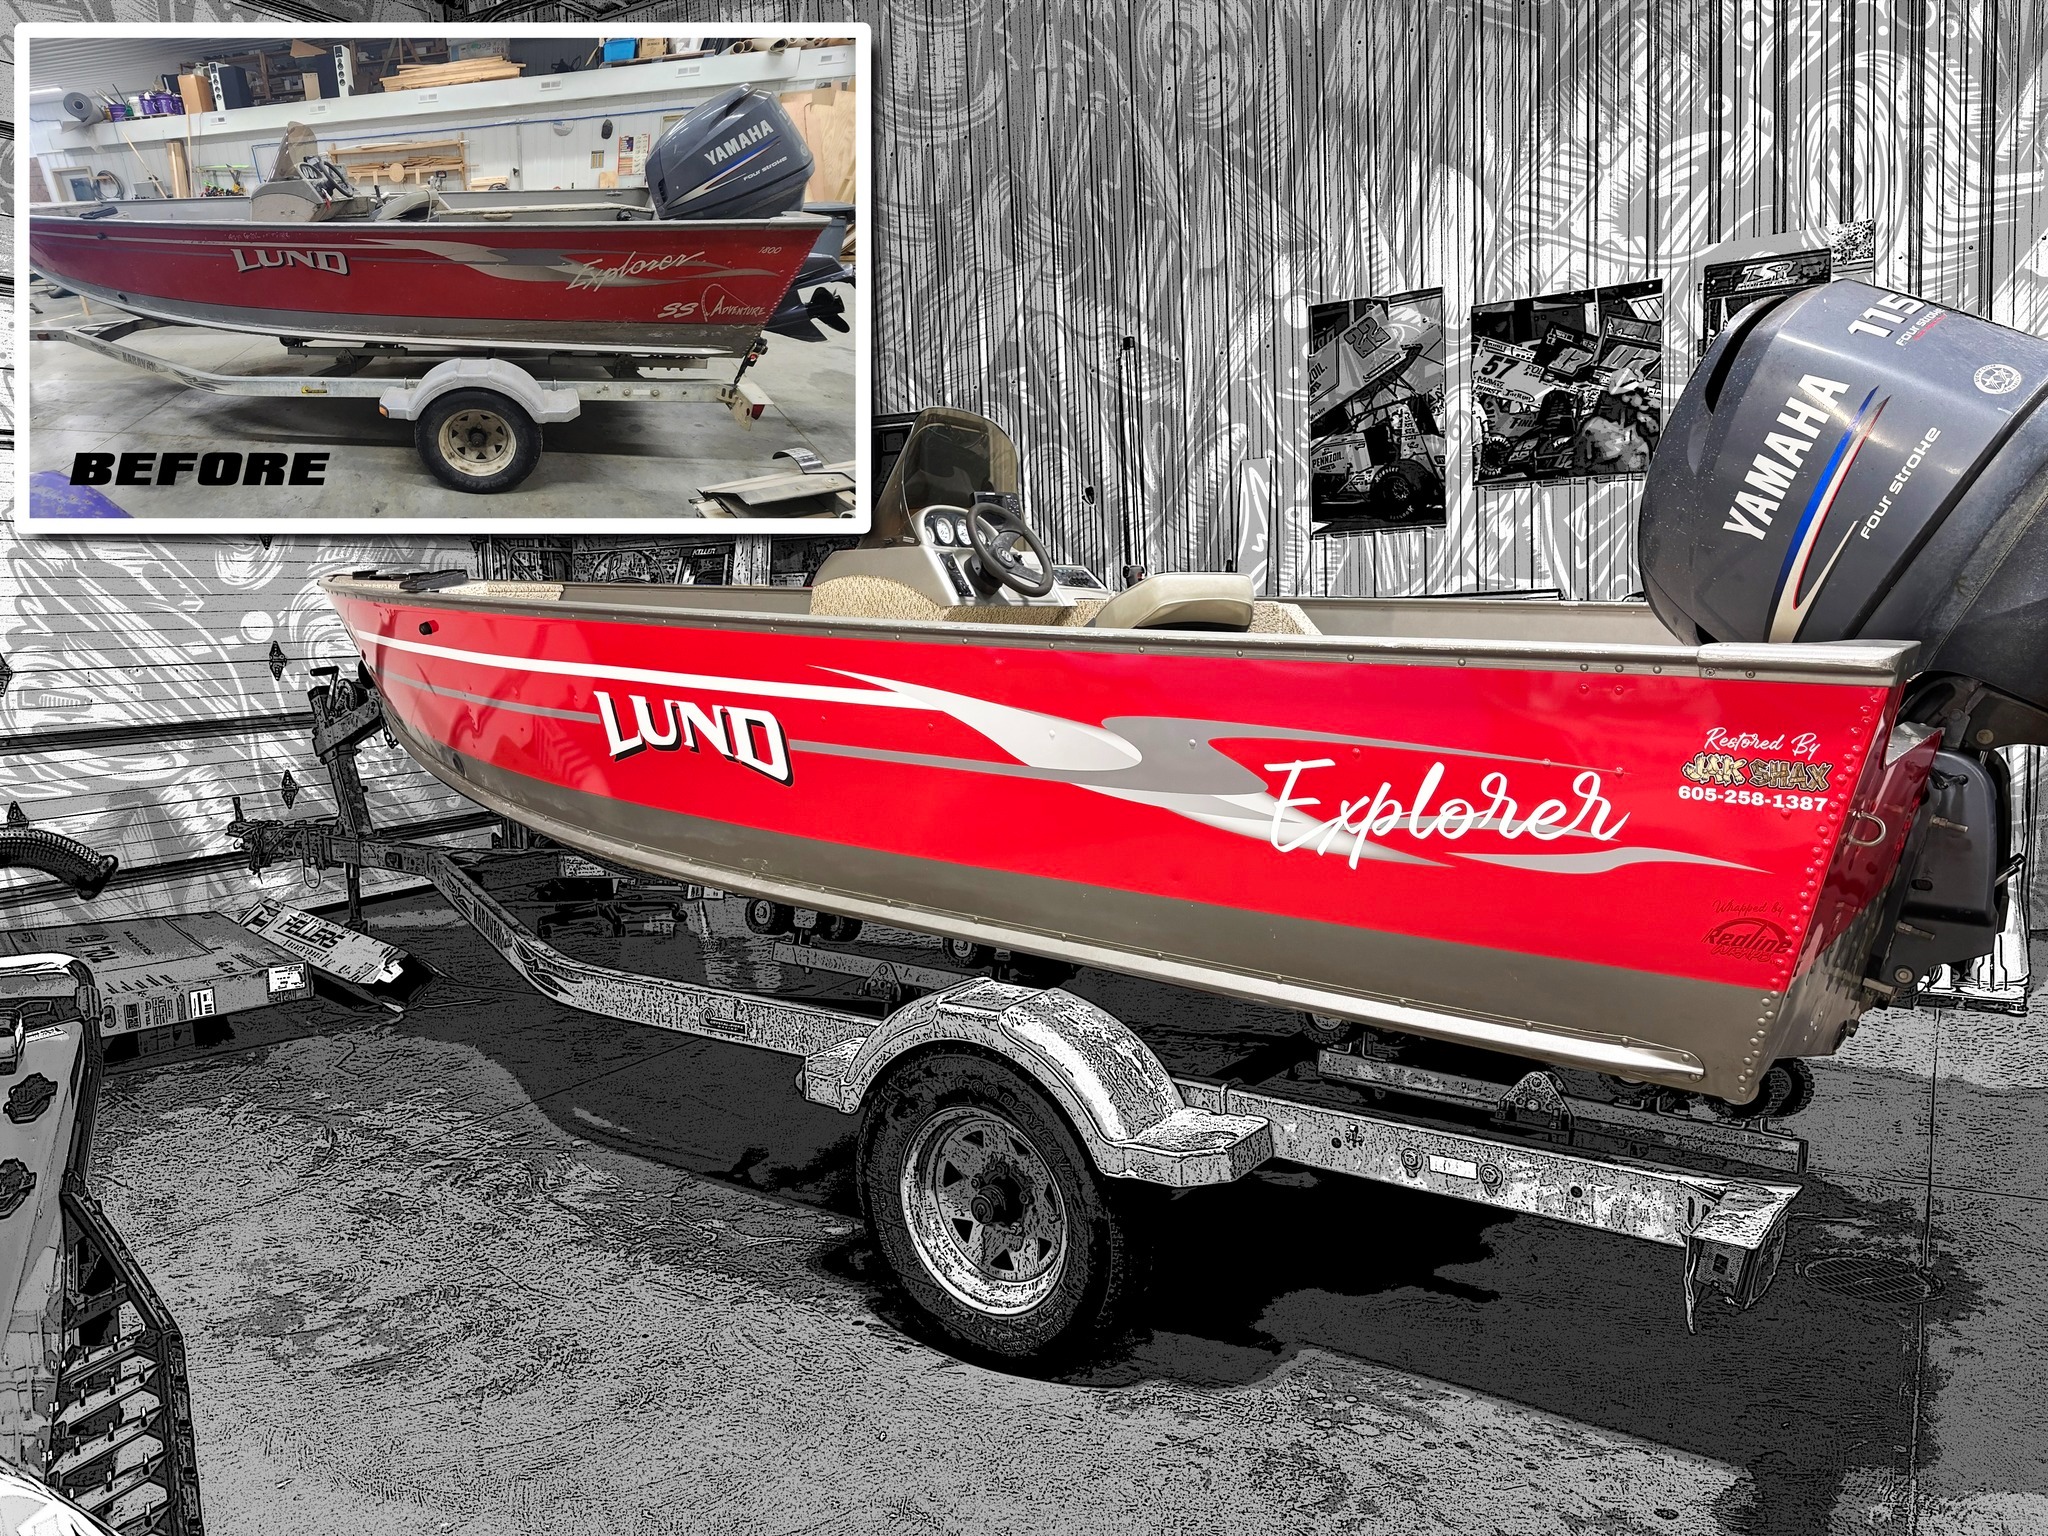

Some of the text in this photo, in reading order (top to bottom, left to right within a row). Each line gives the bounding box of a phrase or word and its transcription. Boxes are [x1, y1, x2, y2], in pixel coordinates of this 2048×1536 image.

[704, 120, 774, 166] YAMAHA
[230, 248, 351, 276] LUND
[758, 246, 782, 254] 1800
[565, 251, 706, 292] Explorer
[657, 302, 699, 318] SS
[1847, 292, 1926, 338] 115
[1481, 354, 1521, 379] 57
[1722, 374, 1851, 541] YAMAHA
[593, 690, 794, 788] LUND
[1704, 727, 1821, 760] Restored By
[1681, 752, 1834, 792] JAK SHAX
[1263, 758, 1632, 871] Explorer
[1678, 785, 1828, 812] 605-258-1387
[1712, 899, 1784, 917] Wrapped by
[278, 914, 346, 949] FELLERS
[1700, 923, 1793, 954] Redline
